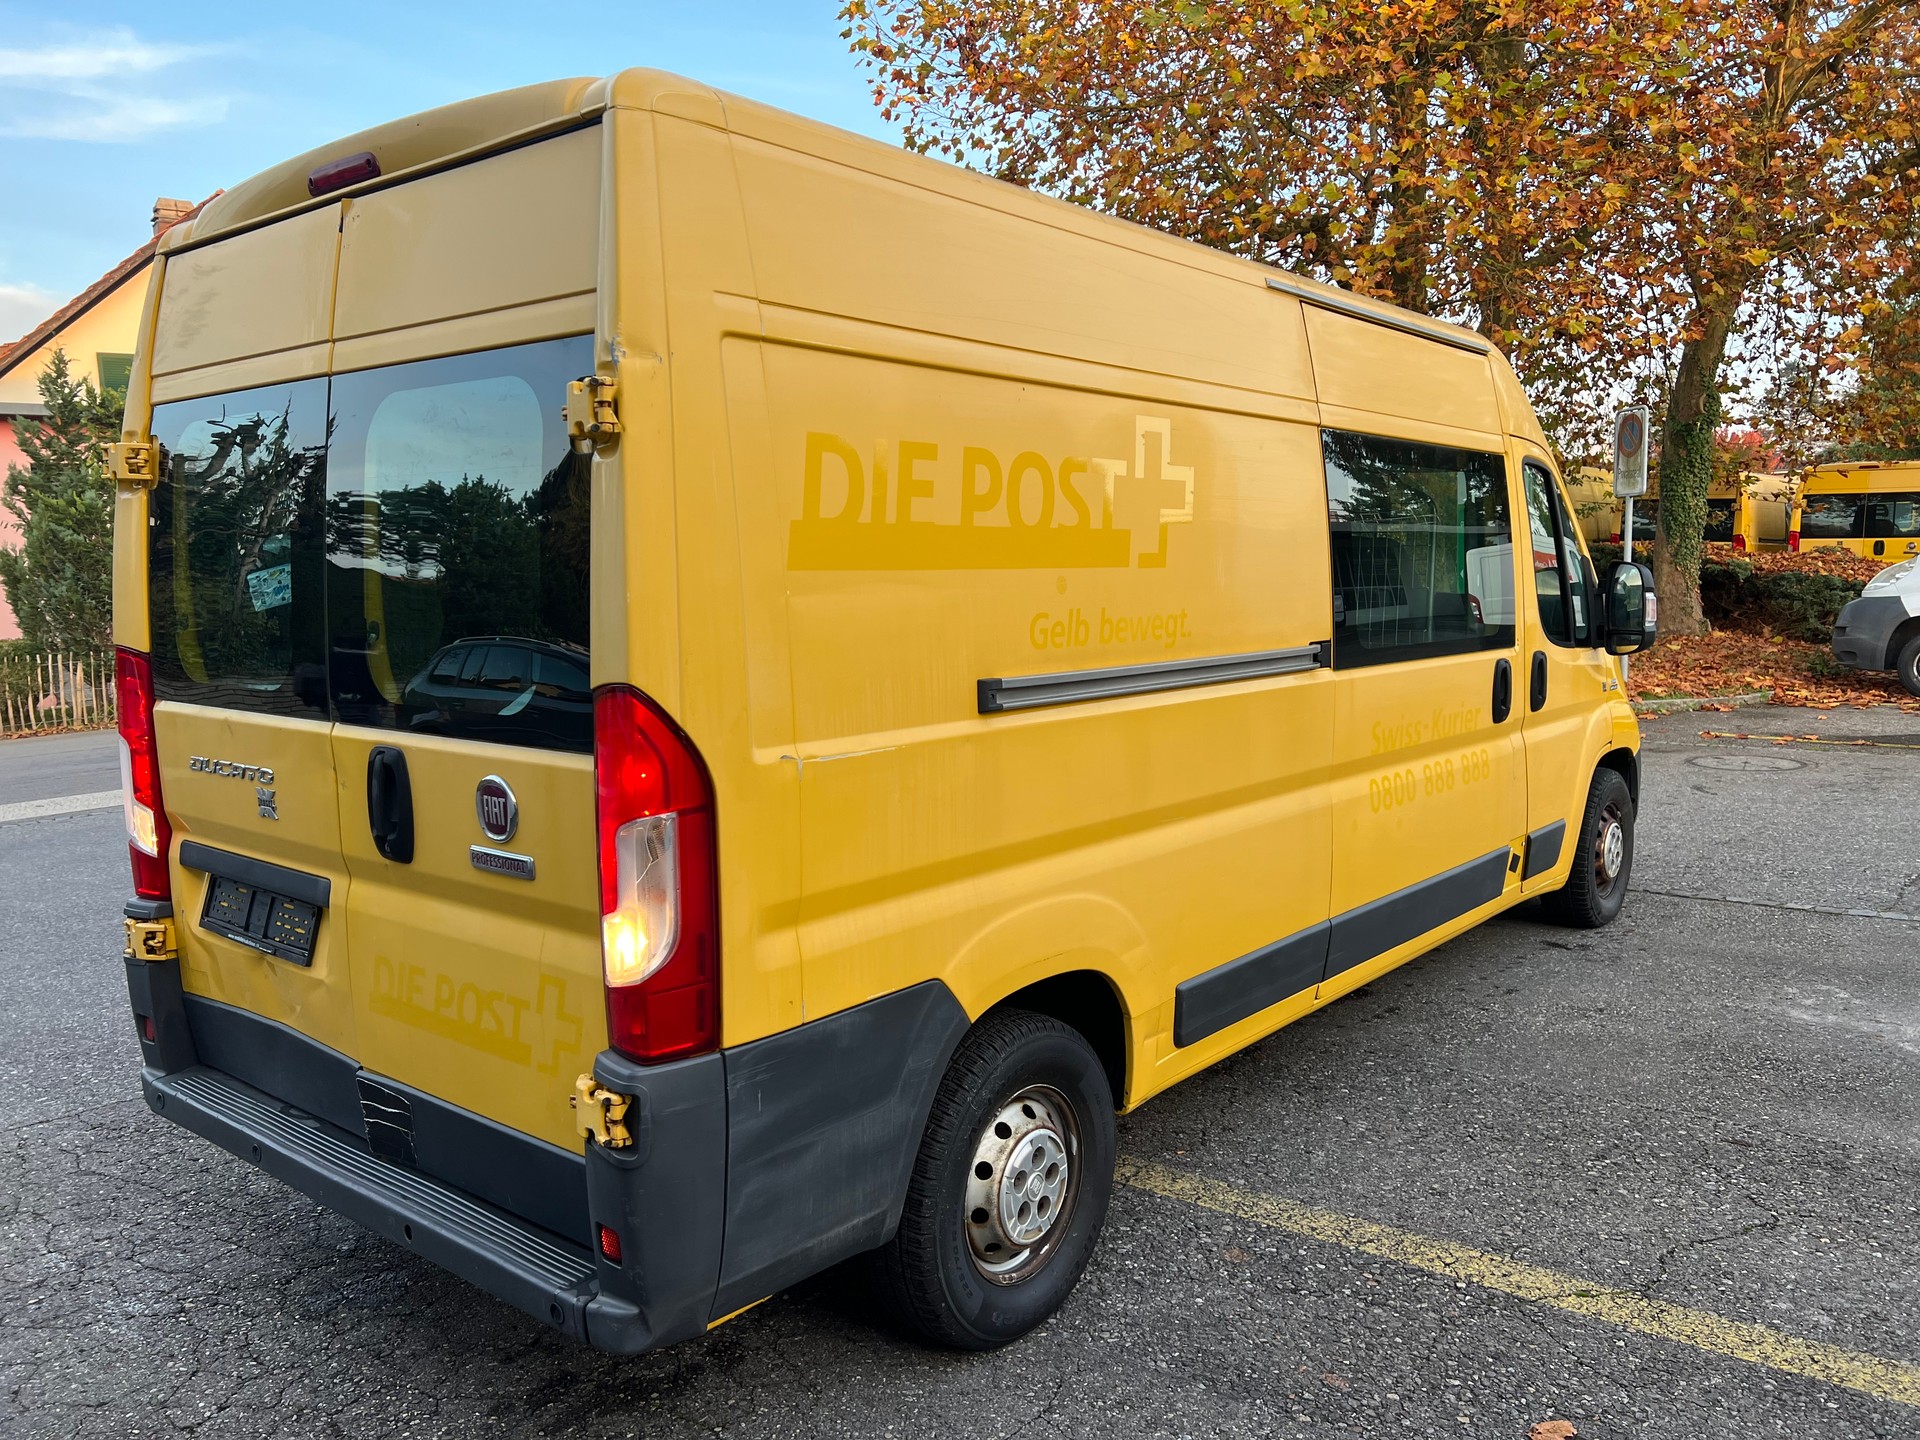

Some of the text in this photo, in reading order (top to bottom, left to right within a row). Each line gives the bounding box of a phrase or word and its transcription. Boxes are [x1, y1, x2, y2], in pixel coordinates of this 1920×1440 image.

[802, 432, 1128, 530] DIE POST
[1029, 607, 1192, 650] Gelb bewegt.
[1371, 702, 1481, 755] Swiss-Kurier
[189, 755, 275, 785] DUCATO
[1369, 748, 1489, 814] 0800 888 888
[483, 795, 505, 826] FIAT
[471, 851, 527, 874] PROFESSIONAL
[373, 955, 531, 1042] DIE POST
